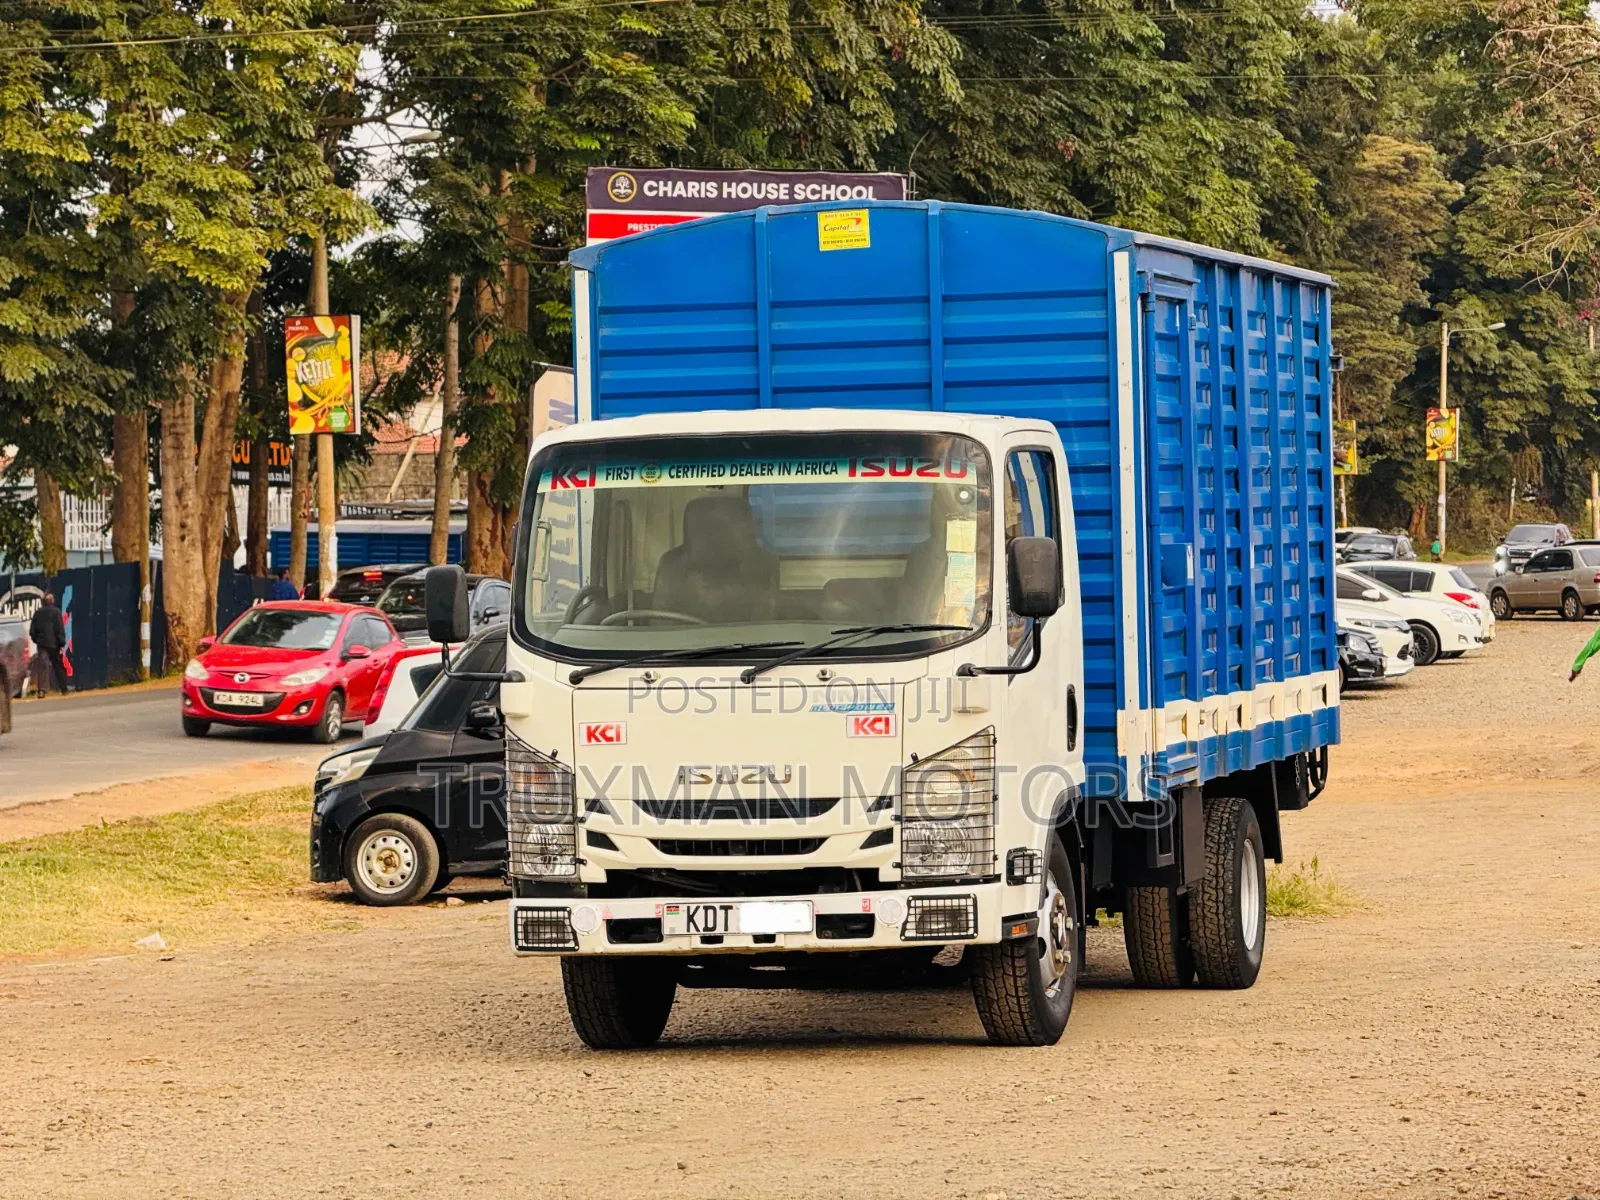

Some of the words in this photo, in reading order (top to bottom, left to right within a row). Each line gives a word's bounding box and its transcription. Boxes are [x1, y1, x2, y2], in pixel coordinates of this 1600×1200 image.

[643, 180, 718, 199] CHARIS
[722, 182, 789, 200] HOUSE
[794, 184, 876, 200] SCHOOL
[823, 224, 850, 232] Capital
[296, 359, 335, 383] KETTLE
[551, 464, 597, 489] KCI
[605, 467, 636, 480] FIRST
[668, 464, 725, 479] CERTIFIED
[729, 462, 774, 478] DEALER
[778, 461, 791, 476] IN
[796, 461, 838, 476] AFRICA
[848, 457, 968, 479] ISUZU
[586, 724, 620, 743] KCI
[854, 717, 890, 735] KCI
[679, 764, 791, 785] ISUZU
[686, 905, 733, 932] KDT
